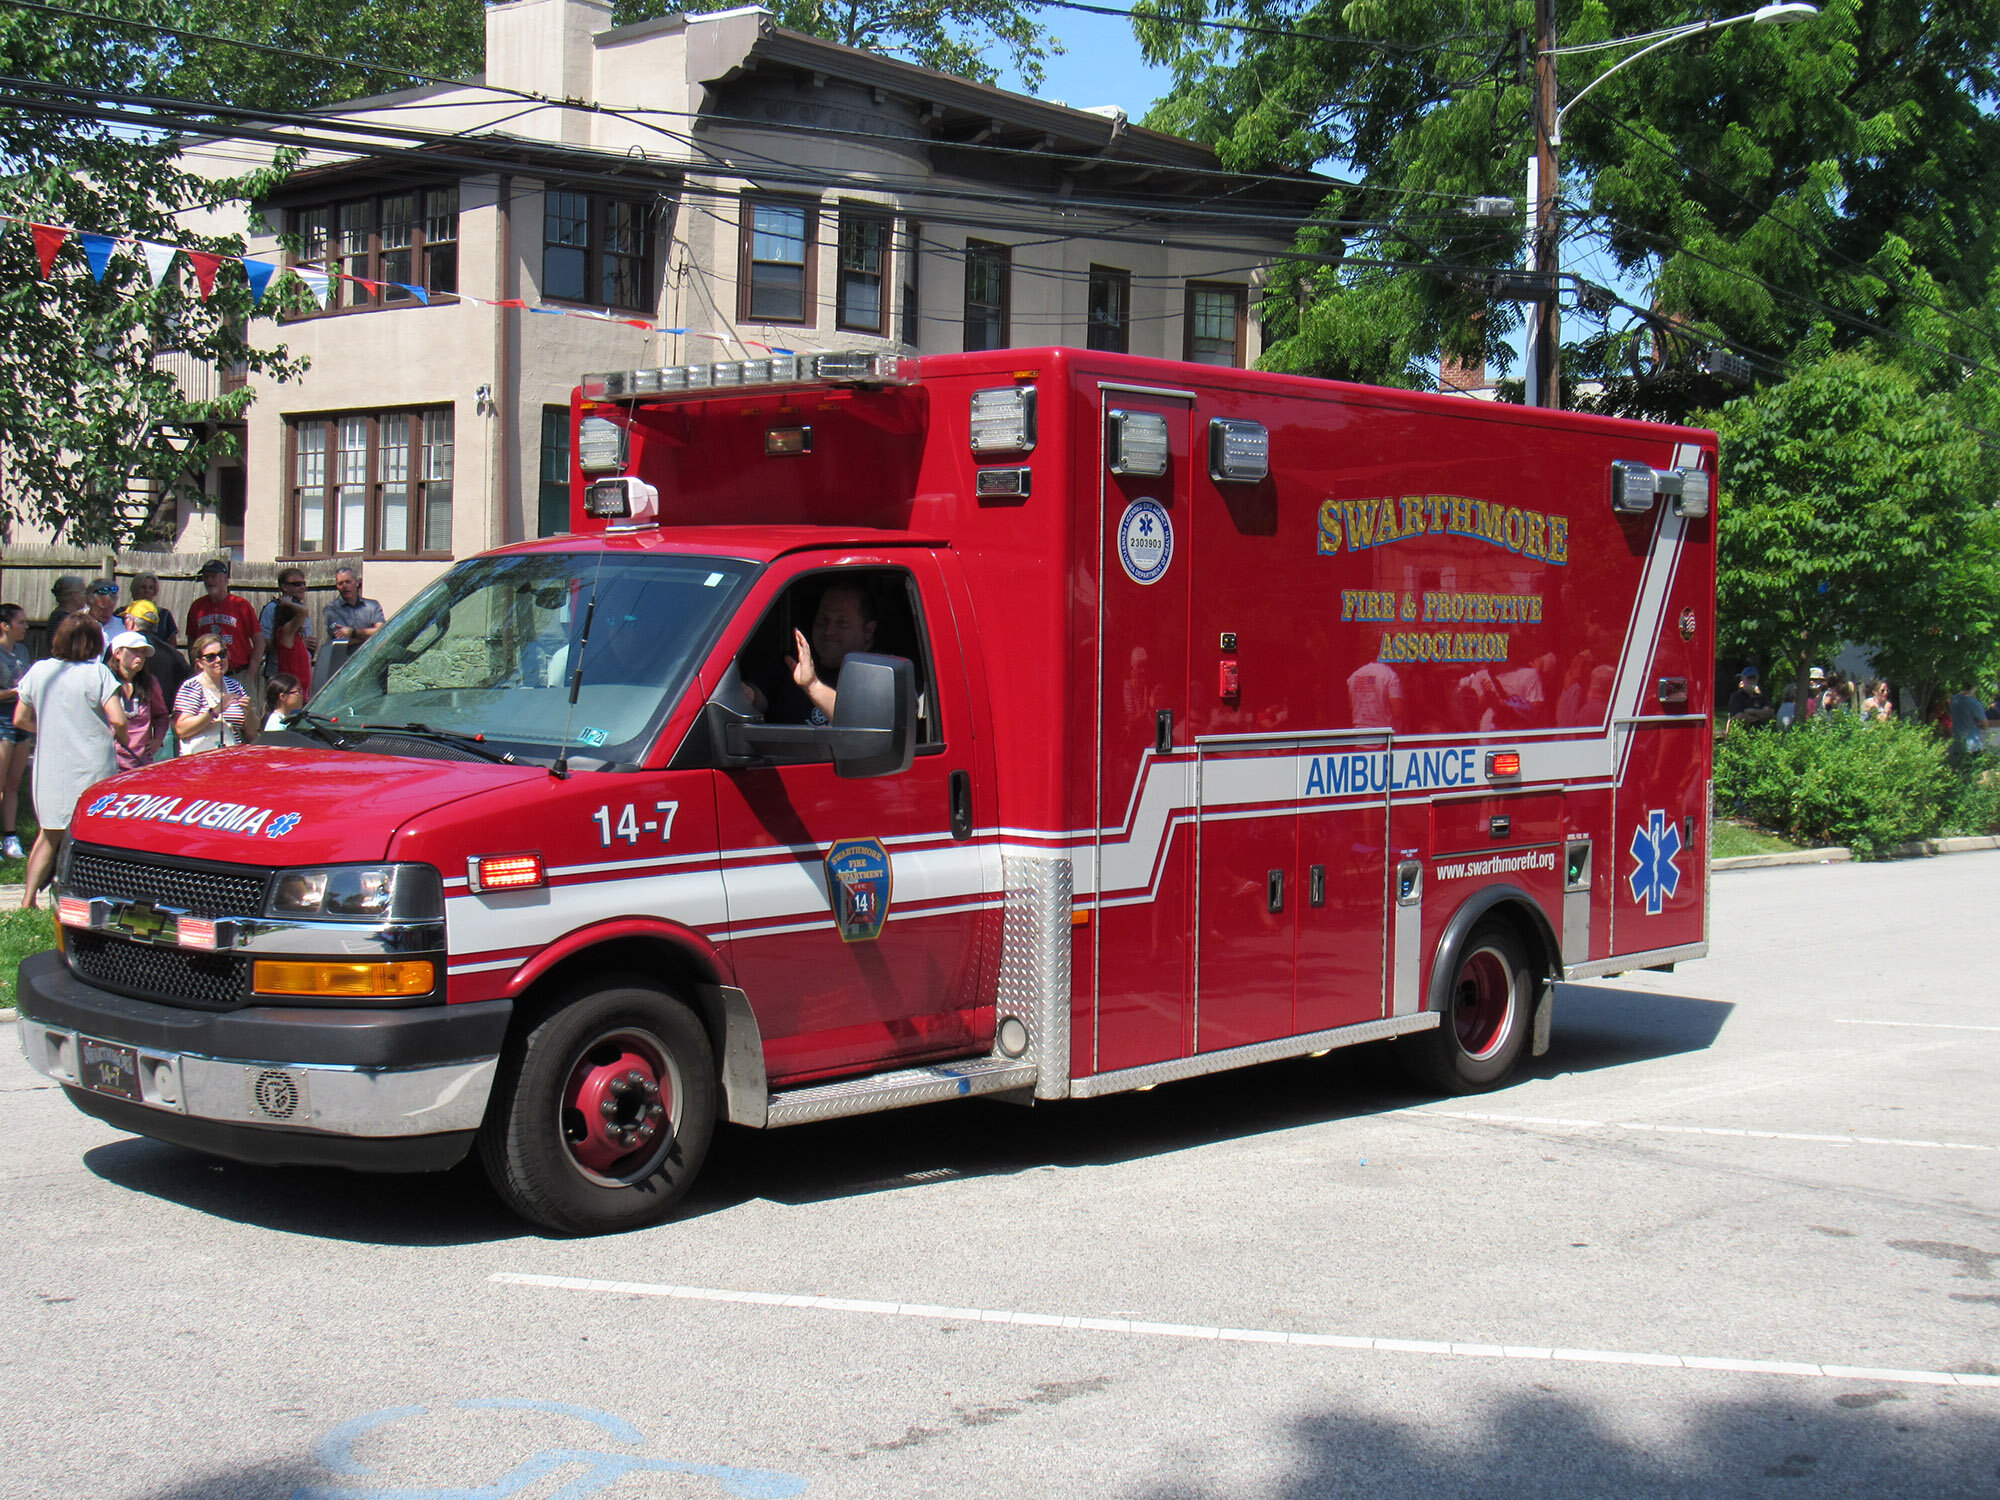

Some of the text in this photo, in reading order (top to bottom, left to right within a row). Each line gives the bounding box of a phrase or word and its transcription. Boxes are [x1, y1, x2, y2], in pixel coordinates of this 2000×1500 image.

[1130, 538, 1162, 549] 2303903
[1318, 495, 1568, 566] SWARTHMORE
[1341, 590, 1543, 623] FIRE & PROTECTIVE
[1377, 633, 1509, 662] ASSOCIATION
[1305, 749, 1476, 795] AMBULANCE
[592, 801, 679, 848] 14-7
[831, 846, 882, 865] SWARTHMORE
[848, 859, 867, 868] FIRE
[1437, 853, 1555, 880] www.swarthmorefd.org
[837, 870, 884, 881] DEPARTMENT
[854, 893, 868, 912] 14
